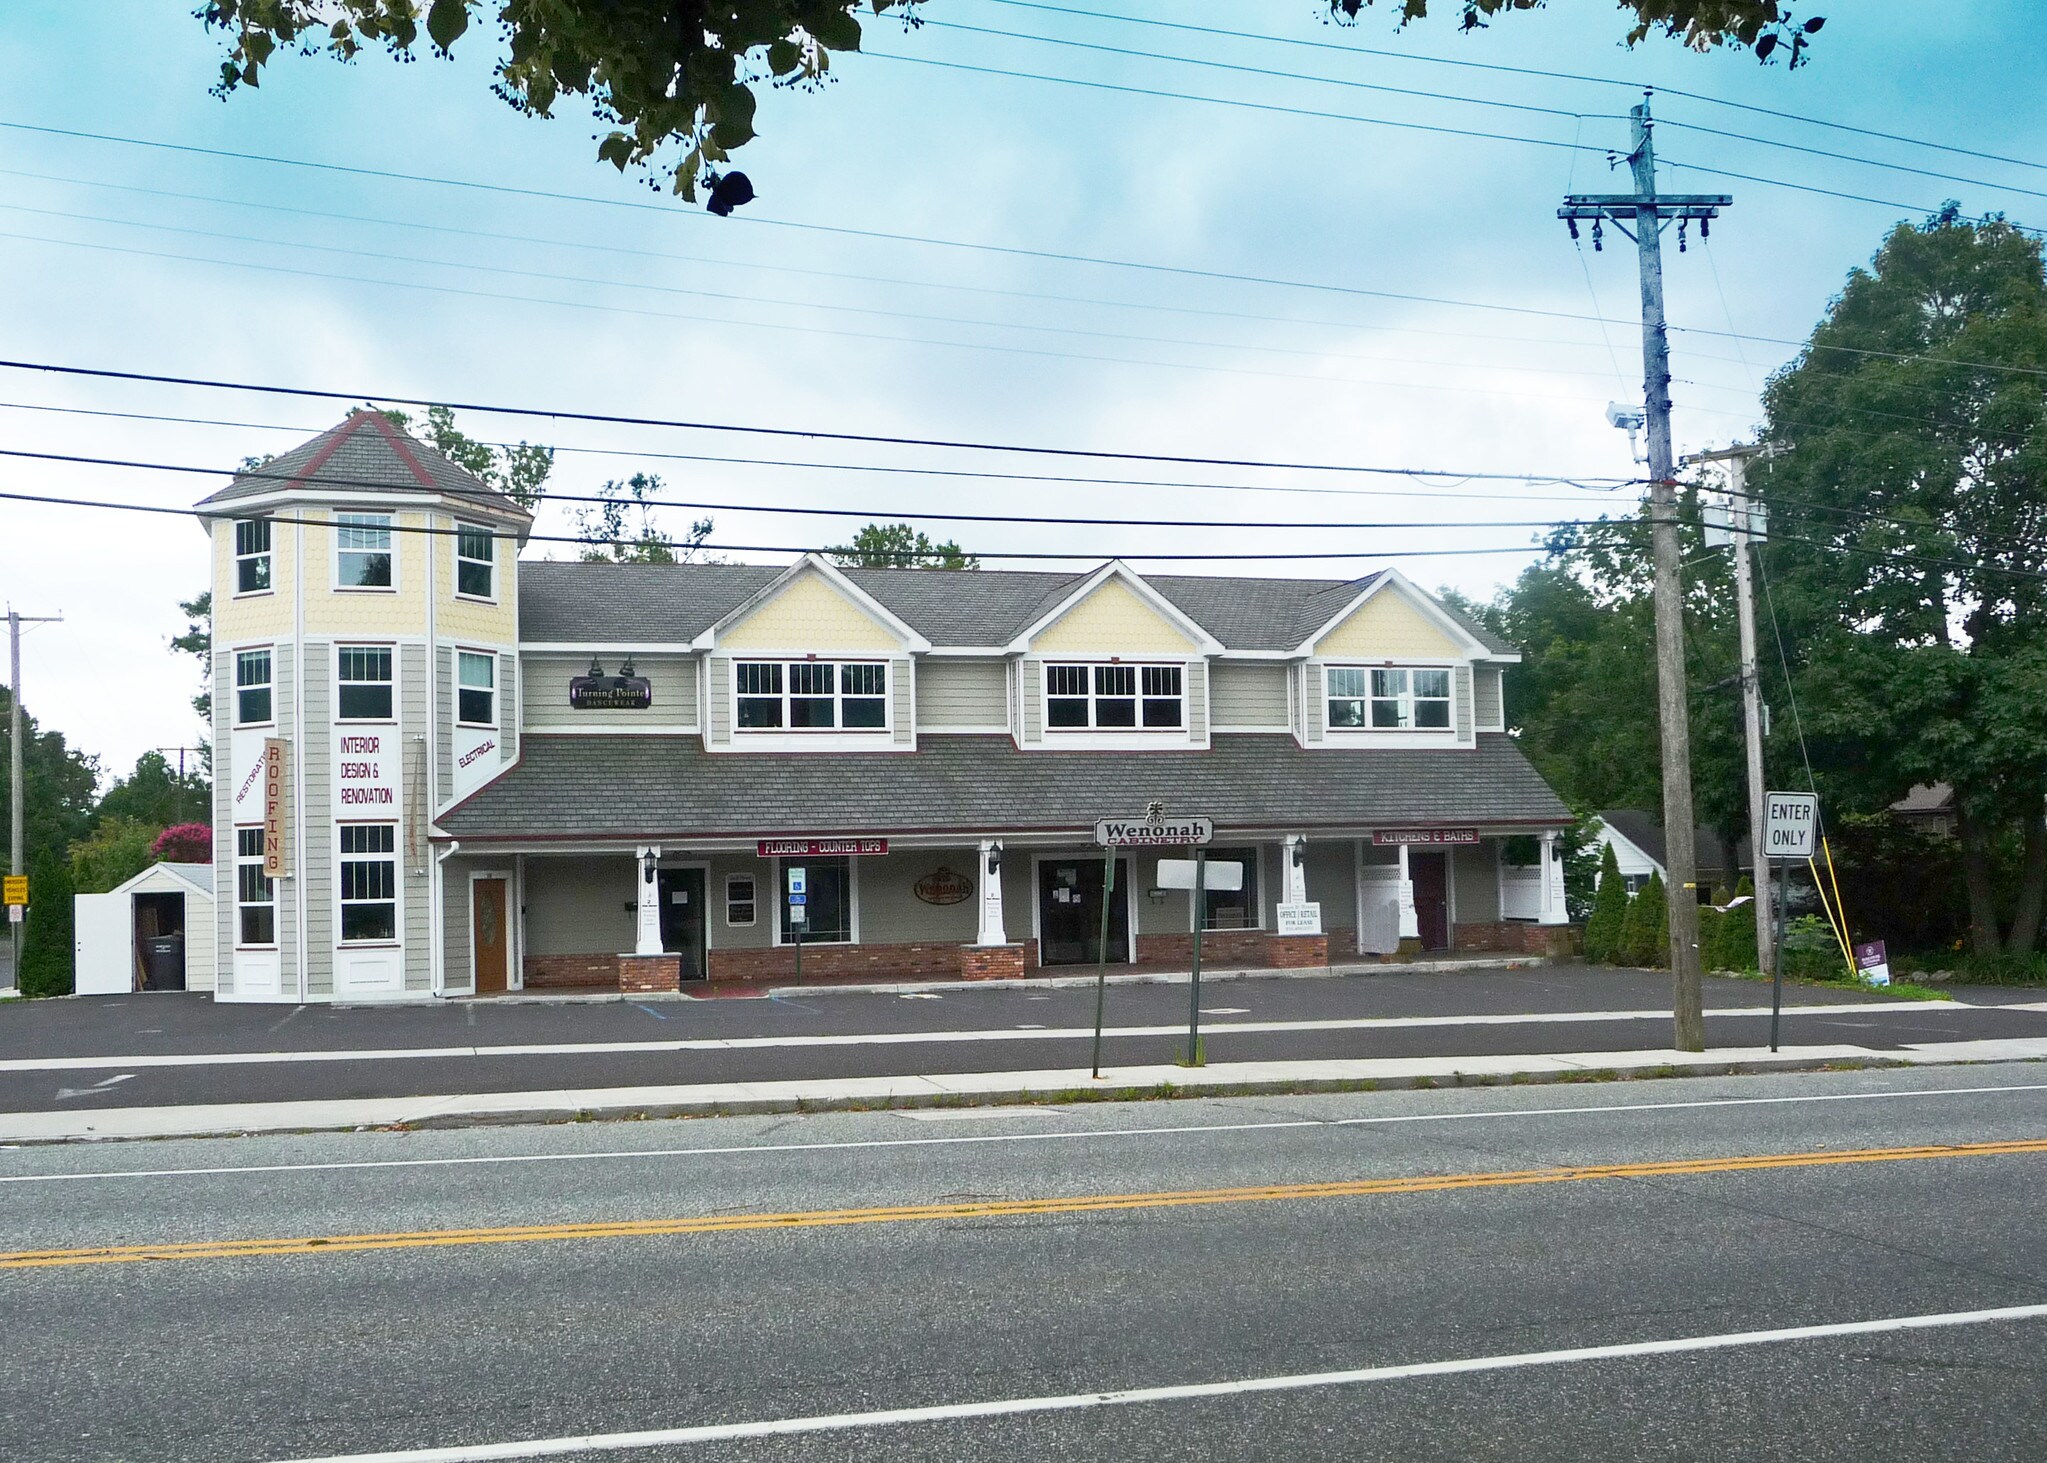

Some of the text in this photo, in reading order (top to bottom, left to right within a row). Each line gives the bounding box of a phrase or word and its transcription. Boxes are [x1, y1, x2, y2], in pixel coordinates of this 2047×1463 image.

[577, 687, 645, 698] Turning Pointe
[340, 737, 380, 754] INTERIOR
[458, 739, 496, 769] ELECTRICAL
[340, 763, 379, 779] DESIGN &
[341, 788, 393, 804] RENOVATION
[267, 746, 281, 870] ROOFING
[1771, 804, 1811, 821] ENTER
[1104, 822, 1205, 838] Wenonah
[1381, 831, 1430, 843] KITCHENS
[1444, 830, 1474, 841] BATHS
[1773, 829, 1806, 846] ONLY
[765, 841, 809, 854] FLOORING
[818, 840, 858, 852] COUNTER
[861, 840, 881, 852] TOPS
[1107, 836, 1202, 845] CABINETRY
[1300, 910, 1318, 918] RETAIL
